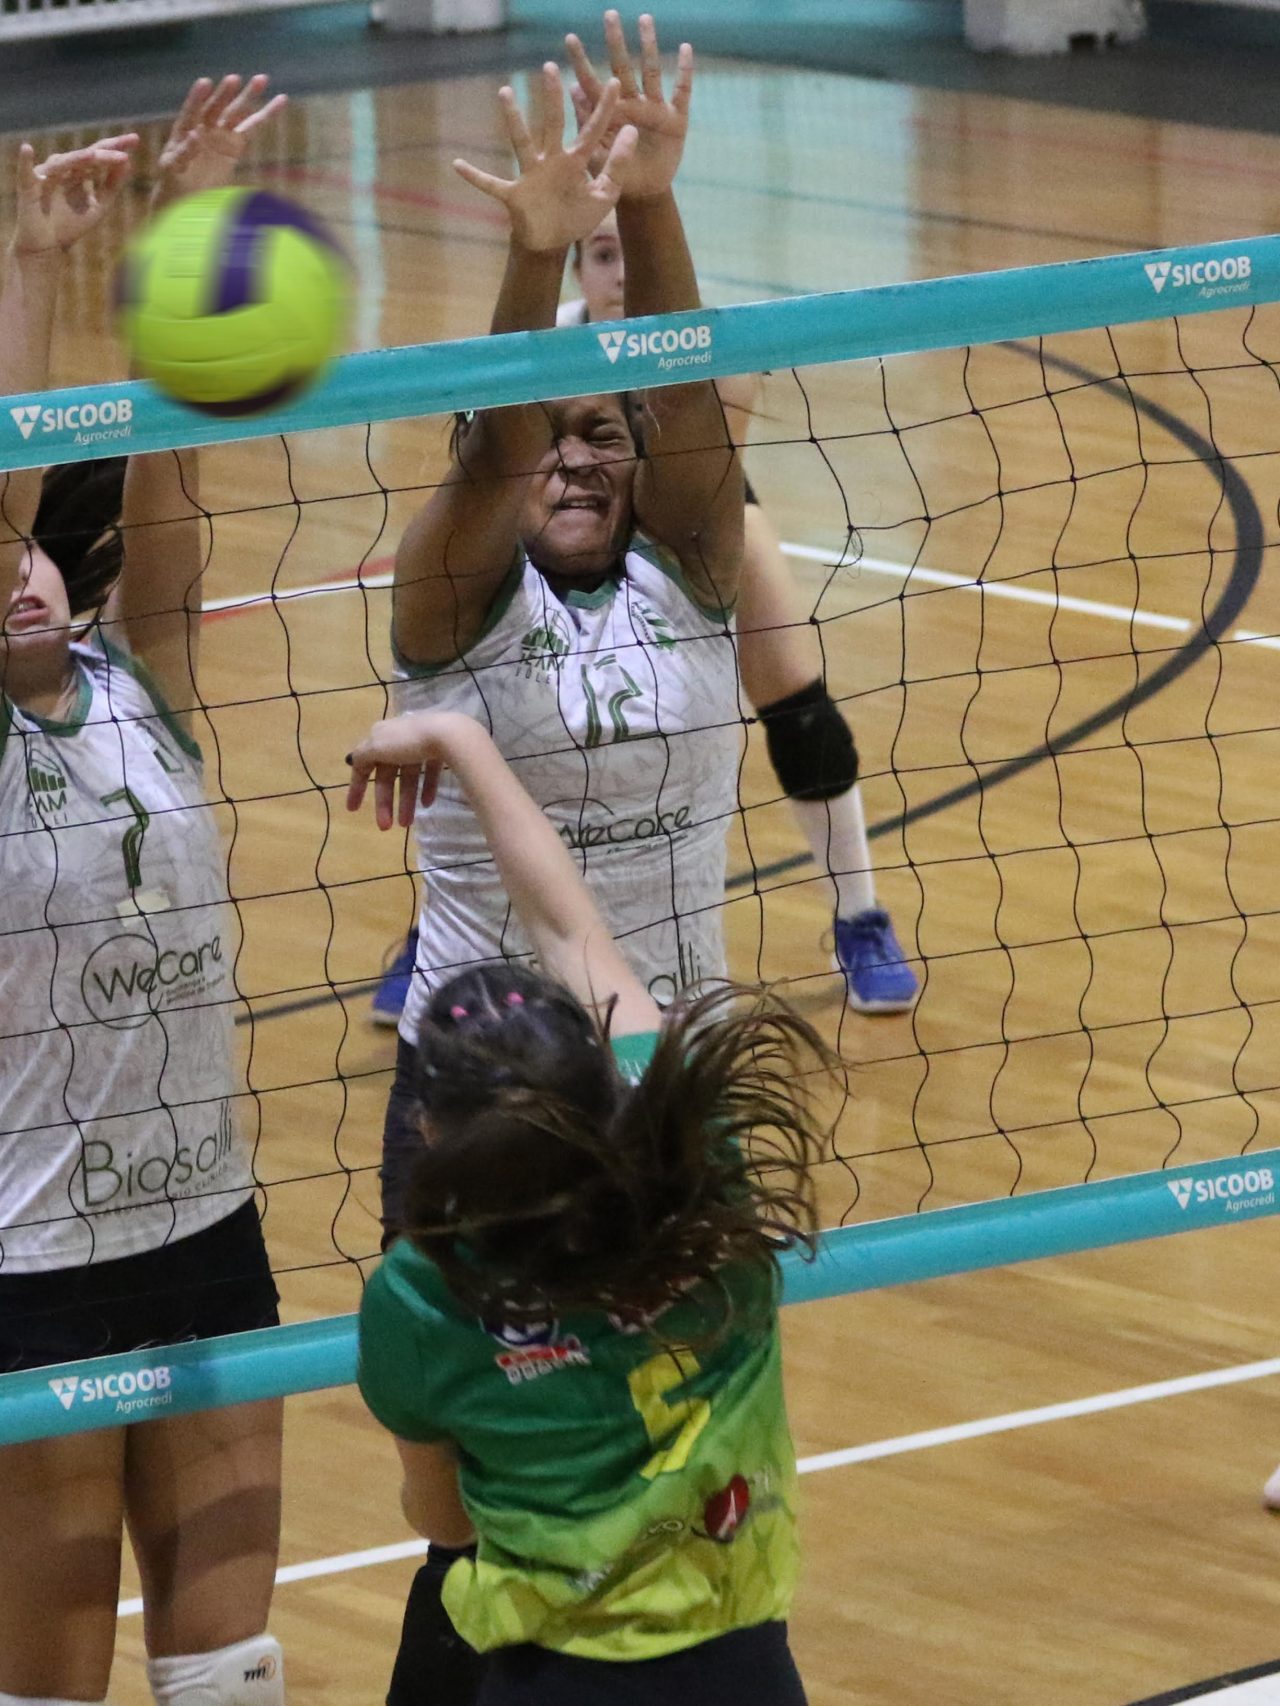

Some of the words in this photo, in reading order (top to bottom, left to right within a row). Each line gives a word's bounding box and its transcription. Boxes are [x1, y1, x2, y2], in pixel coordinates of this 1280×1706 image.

[1172, 256, 1252, 288] SICOOB
[1199, 279, 1251, 298] Agrocredi
[626, 325, 712, 357] SICOOB
[657, 350, 712, 370] Agrocredi
[42, 398, 133, 433] SICOOB
[73, 425, 132, 446] Agrocredi
[100, 786, 150, 889] 7
[93, 936, 222, 1004] WeCare
[82, 1098, 232, 1207] Biosalli
[1195, 1168, 1274, 1202] SICOOB
[1225, 1192, 1275, 1213] Agrocredi
[81, 1366, 171, 1402] SICOOB
[116, 1392, 172, 1414] Agrocredi
